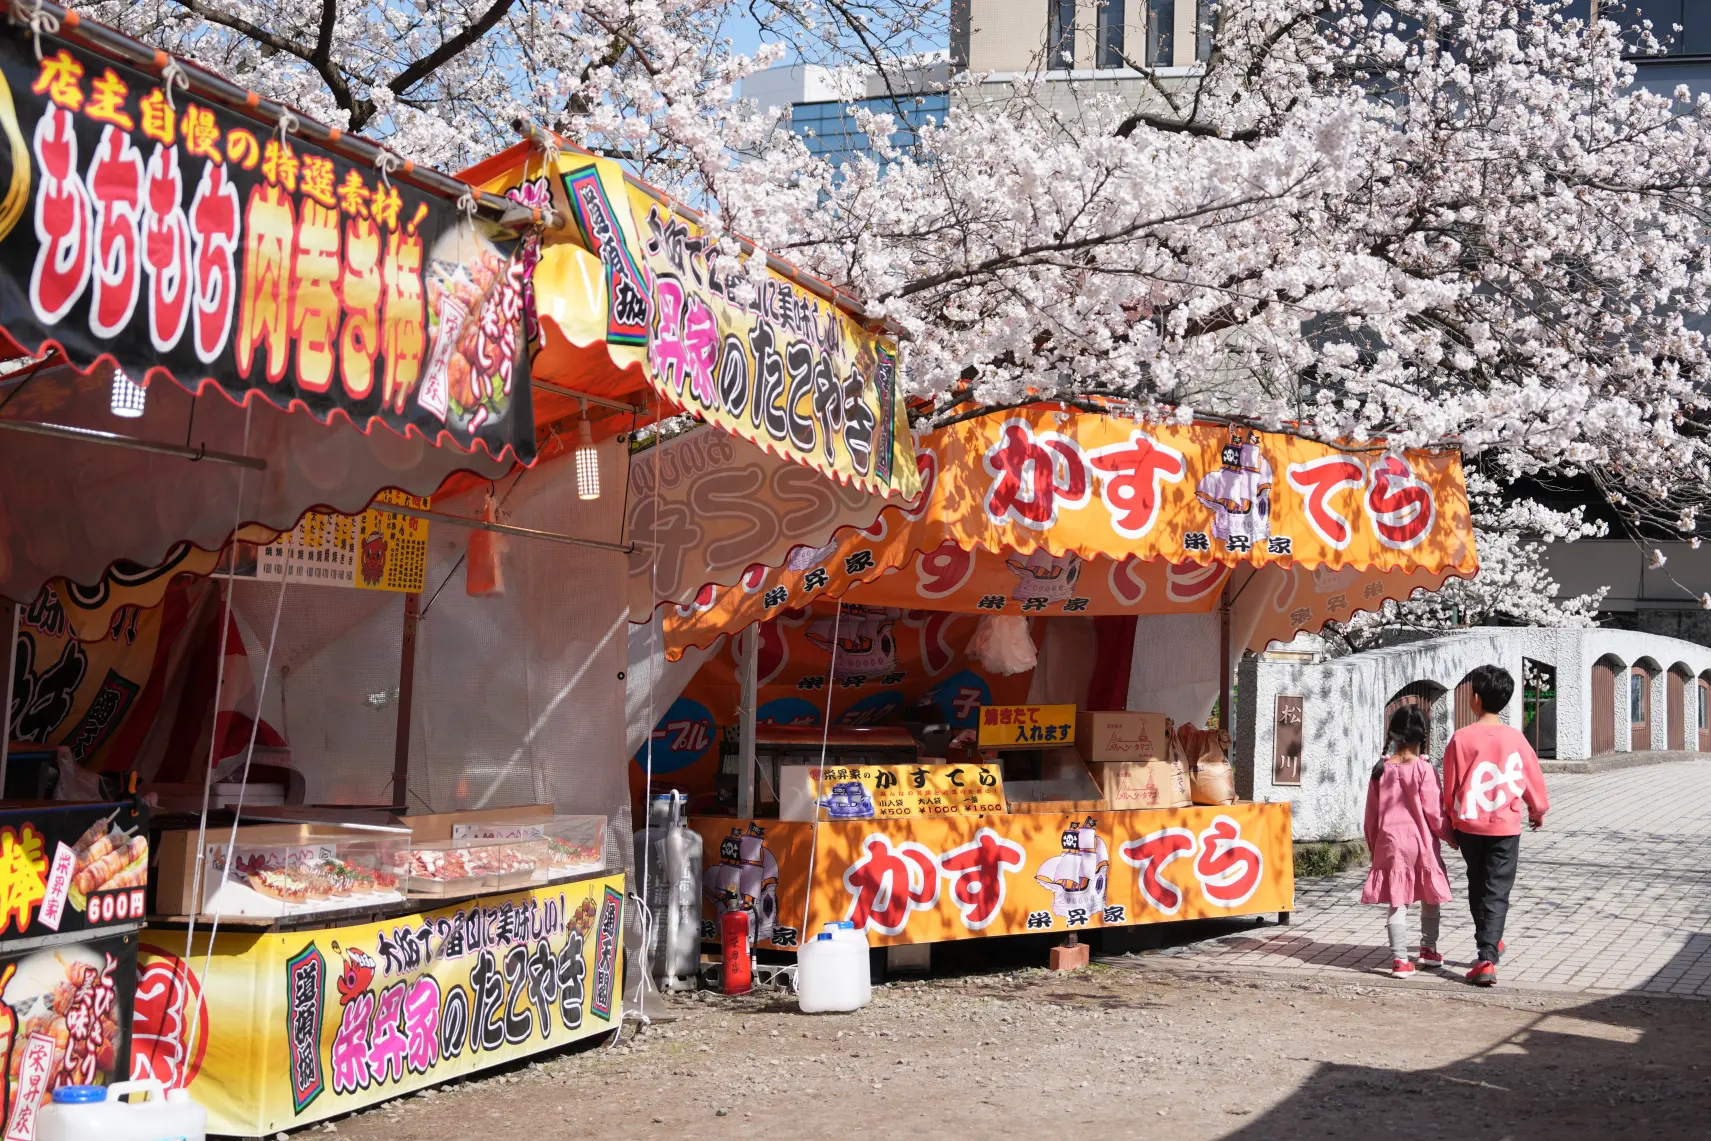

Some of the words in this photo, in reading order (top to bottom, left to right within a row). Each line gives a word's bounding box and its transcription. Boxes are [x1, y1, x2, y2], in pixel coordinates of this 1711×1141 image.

[29, 99, 241, 364] もちもち
[235, 182, 427, 414] 肉巻き棒
[647, 268, 876, 477] 昇家のたこやき
[983, 415, 1187, 540] かす
[1285, 452, 1437, 550] てら
[1182, 530, 1293, 555] 栄昇家
[976, 594, 1091, 612] 栄昇家
[797, 671, 908, 690] 栄昇家
[984, 707, 1041, 726] 焼きたて
[1015, 723, 1072, 742] 入れます
[1278, 703, 1302, 778] 松川
[875, 767, 997, 789] かすてら
[880, 807, 911, 815] ¥500
[965, 804, 1002, 812] ¥1500
[843, 826, 1026, 937] かす
[1119, 814, 1264, 916] てら
[86, 889, 146, 924] 600円
[1027, 906, 1126, 930] 栄昇家
[331, 931, 587, 1096] 栄昇家のたこやき
[12, 1043, 50, 1137] 栄昇家
